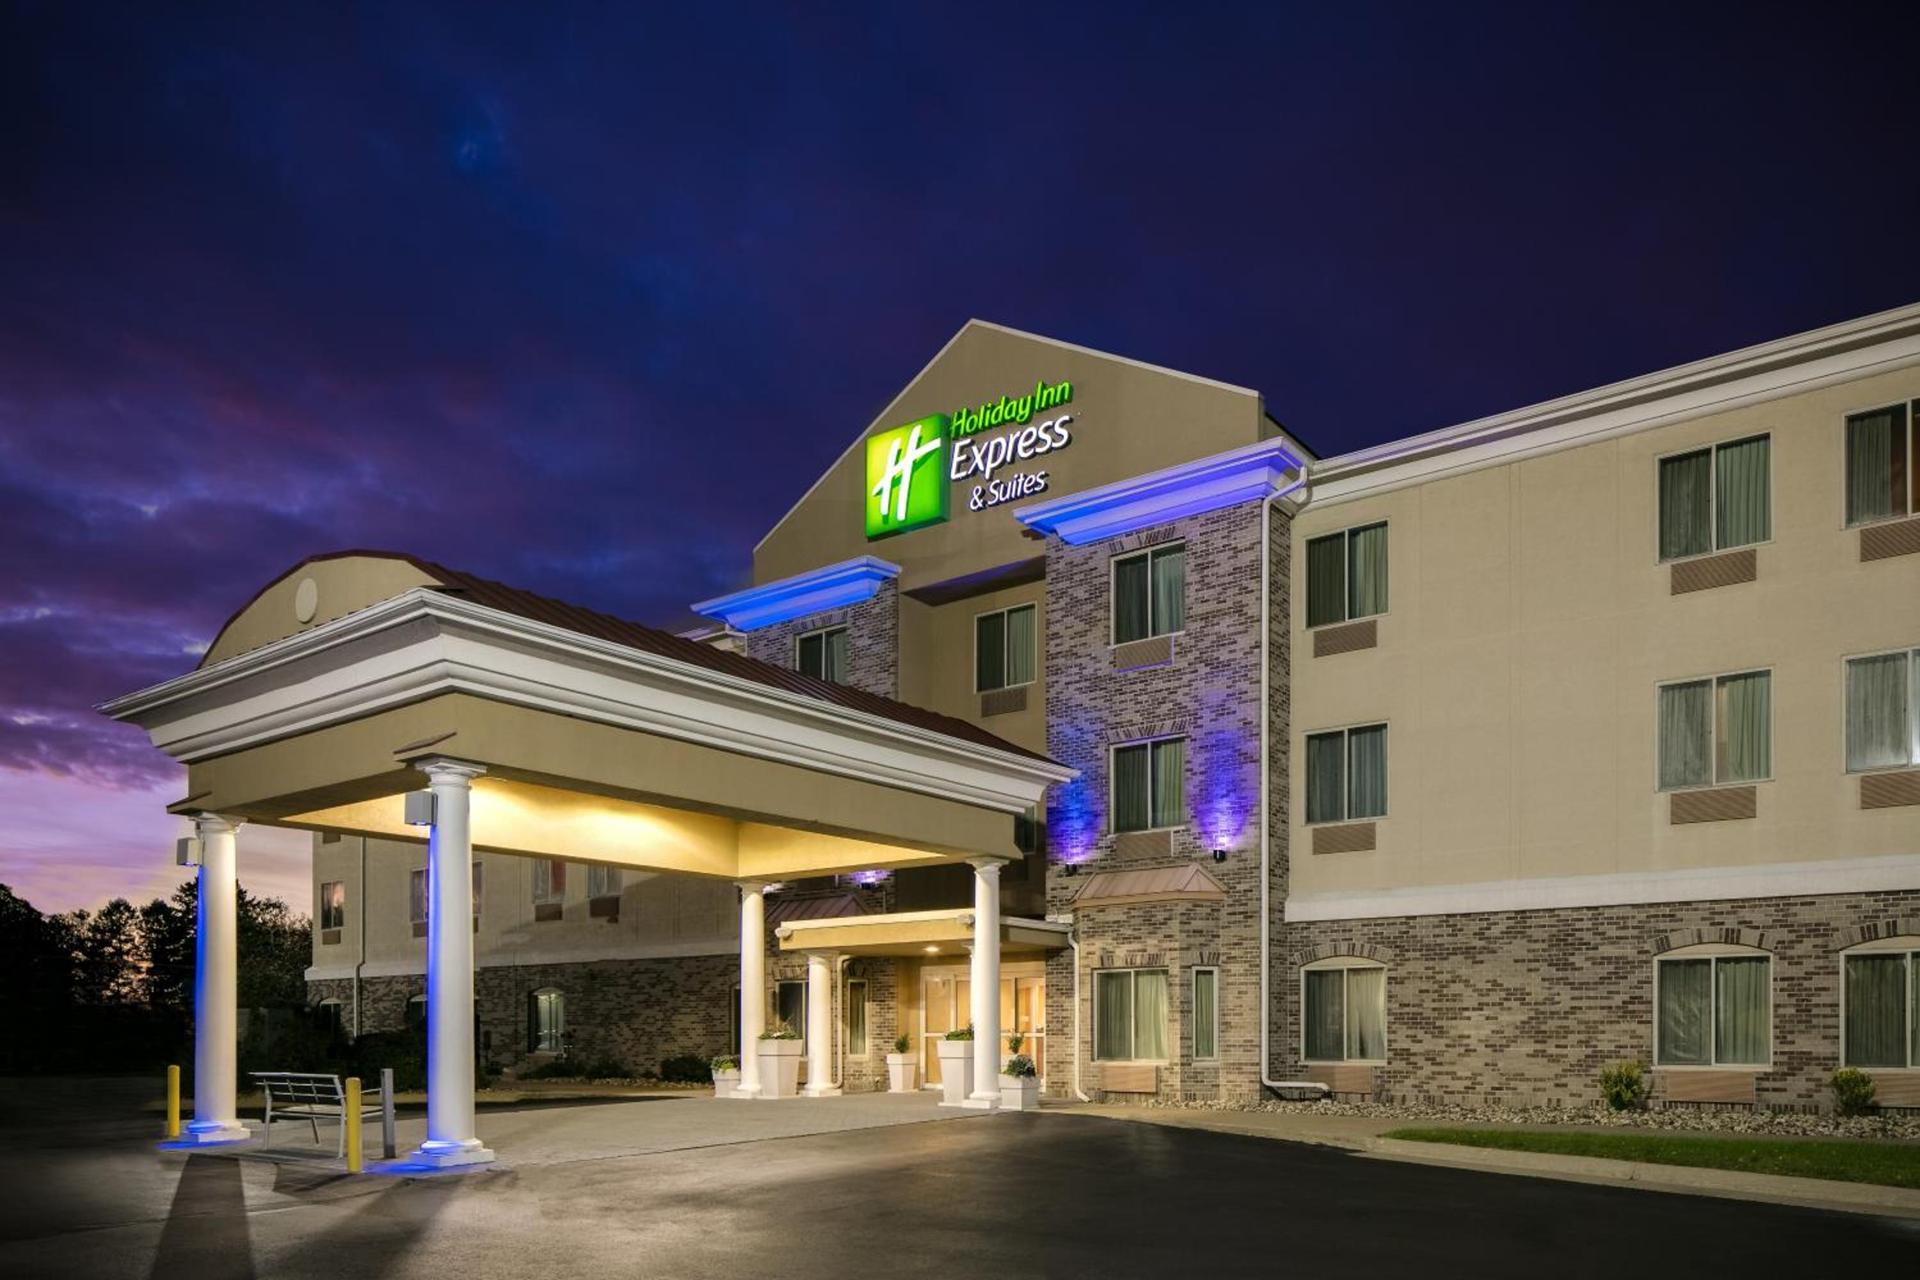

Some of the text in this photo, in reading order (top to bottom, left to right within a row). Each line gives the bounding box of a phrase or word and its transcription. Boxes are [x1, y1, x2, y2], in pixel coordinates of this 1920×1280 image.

[951, 380, 1072, 438] Holiday Inn
[950, 415, 1071, 480] Express
[969, 471, 1046, 512] & Suites
